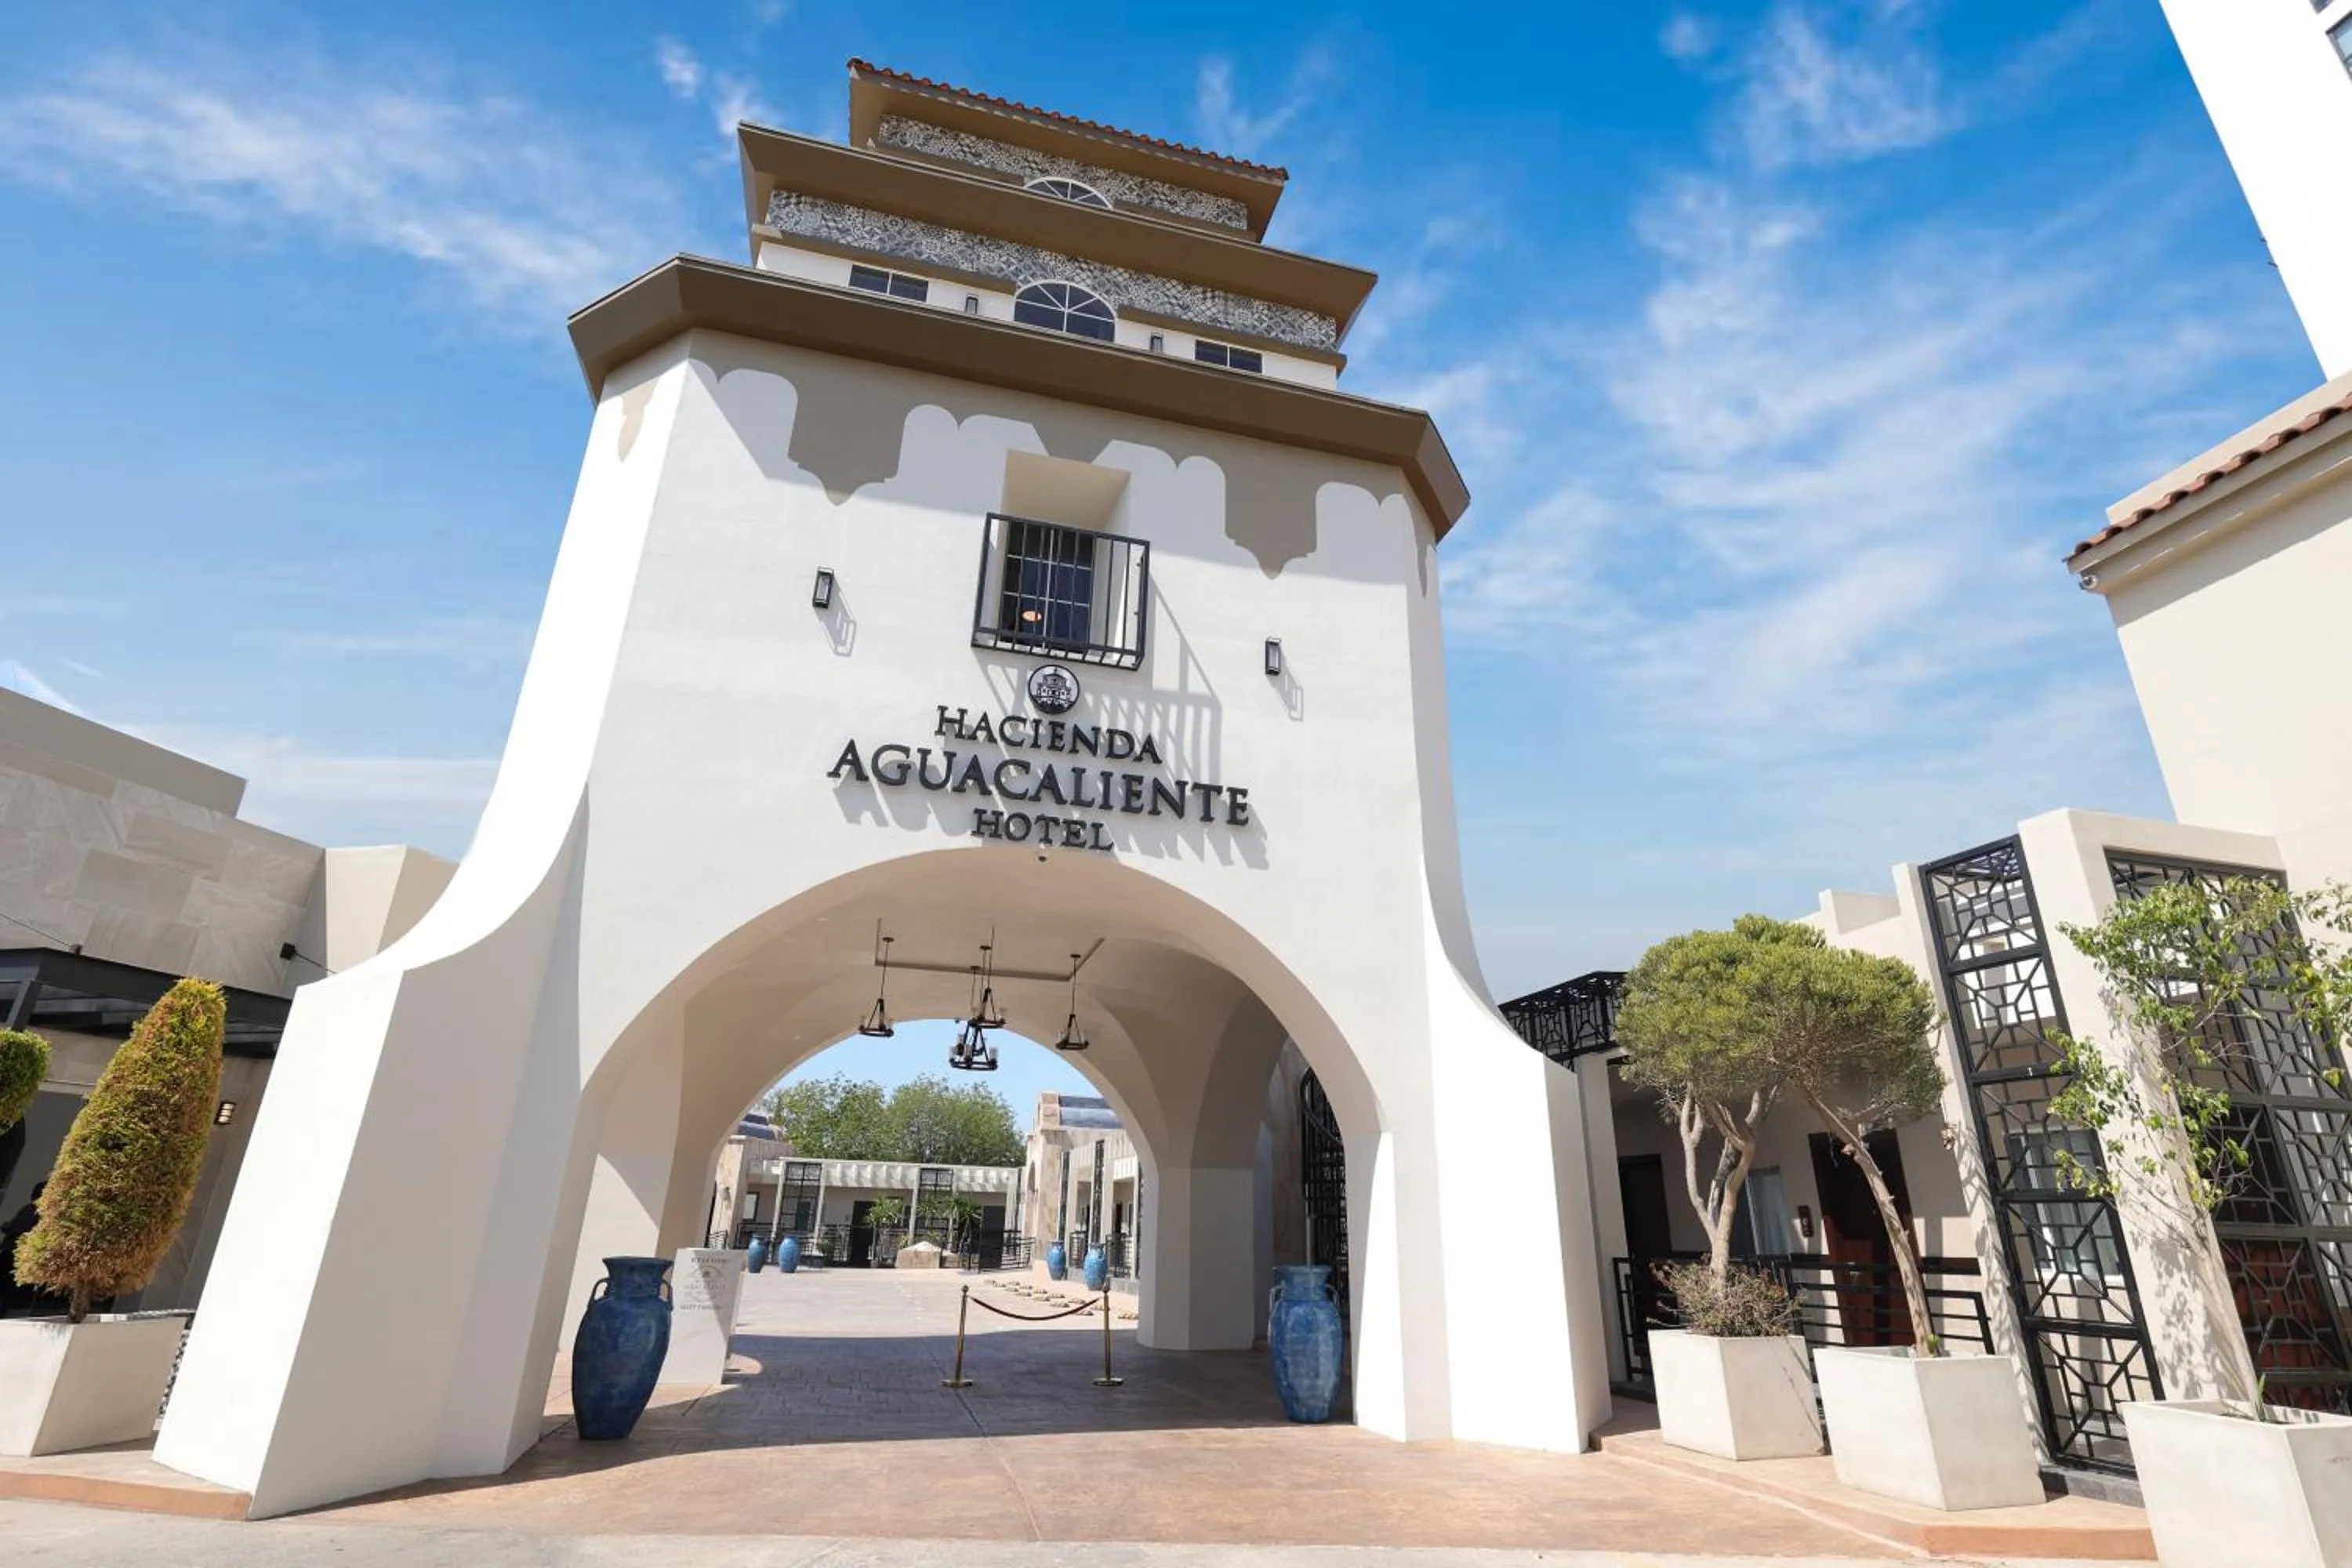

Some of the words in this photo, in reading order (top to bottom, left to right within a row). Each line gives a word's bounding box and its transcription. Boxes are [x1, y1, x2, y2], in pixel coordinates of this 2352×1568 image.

[934, 705, 1163, 764] HACIENDA
[827, 739, 1249, 826] AGUACALIENTE
[971, 808, 1113, 851] HOTEL
